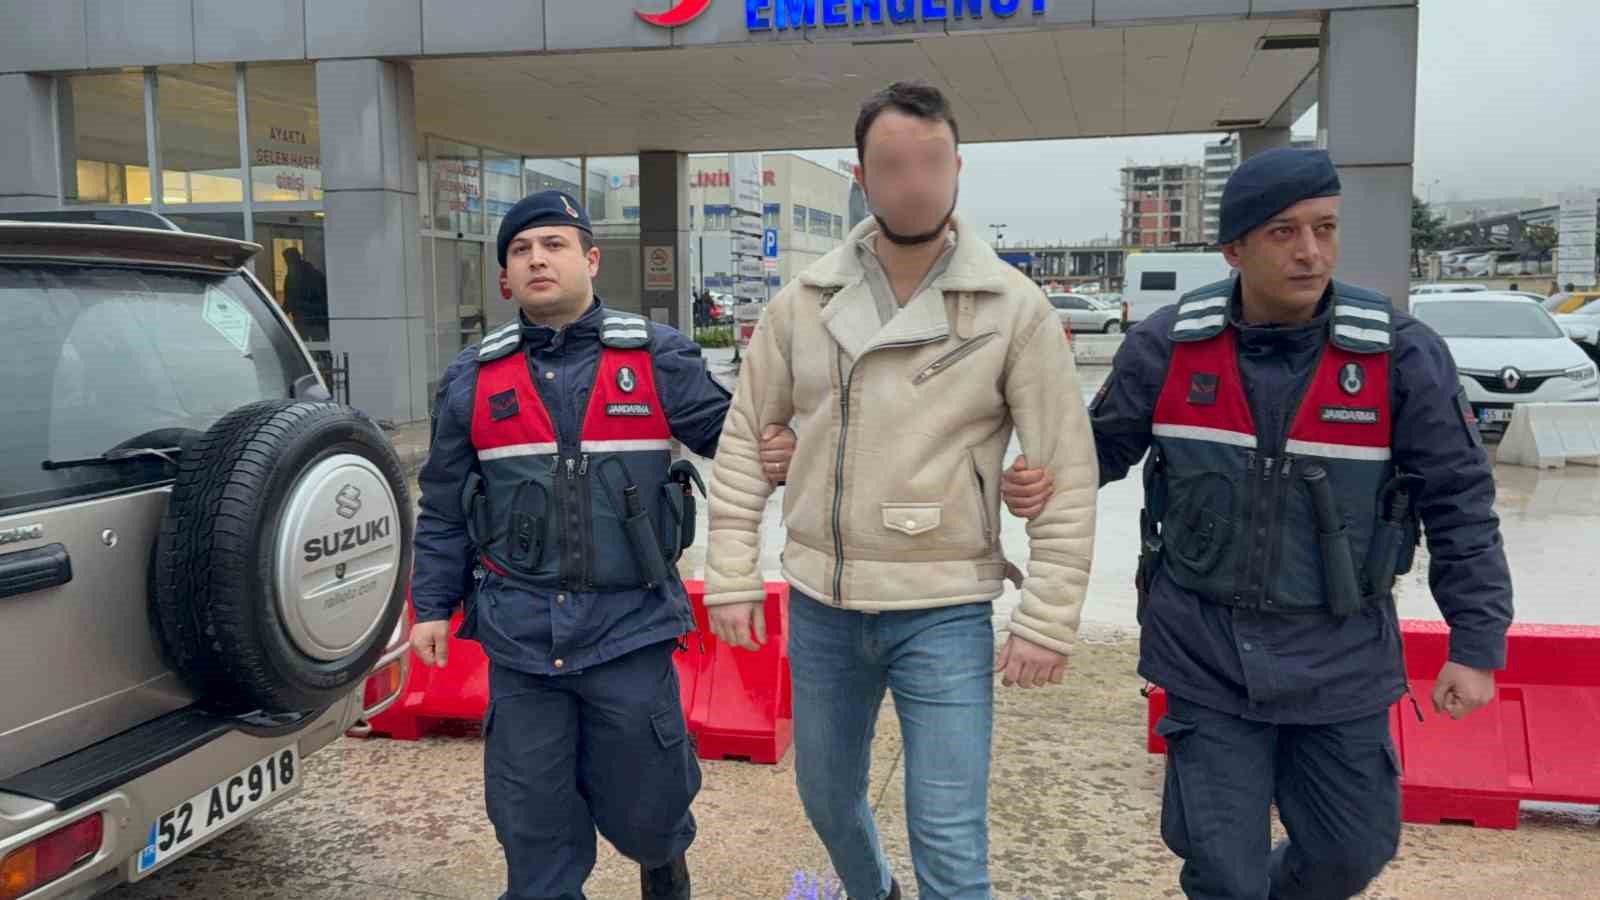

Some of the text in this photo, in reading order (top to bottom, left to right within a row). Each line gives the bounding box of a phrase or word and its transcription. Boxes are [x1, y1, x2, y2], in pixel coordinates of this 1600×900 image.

[767, 230, 776, 255] P
[608, 404, 649, 415] JANDARMA
[1323, 409, 1377, 421] JANDARMA
[304, 516, 389, 562] SUZUKI
[159, 802, 193, 851] 52
[207, 750, 294, 827] AC918
